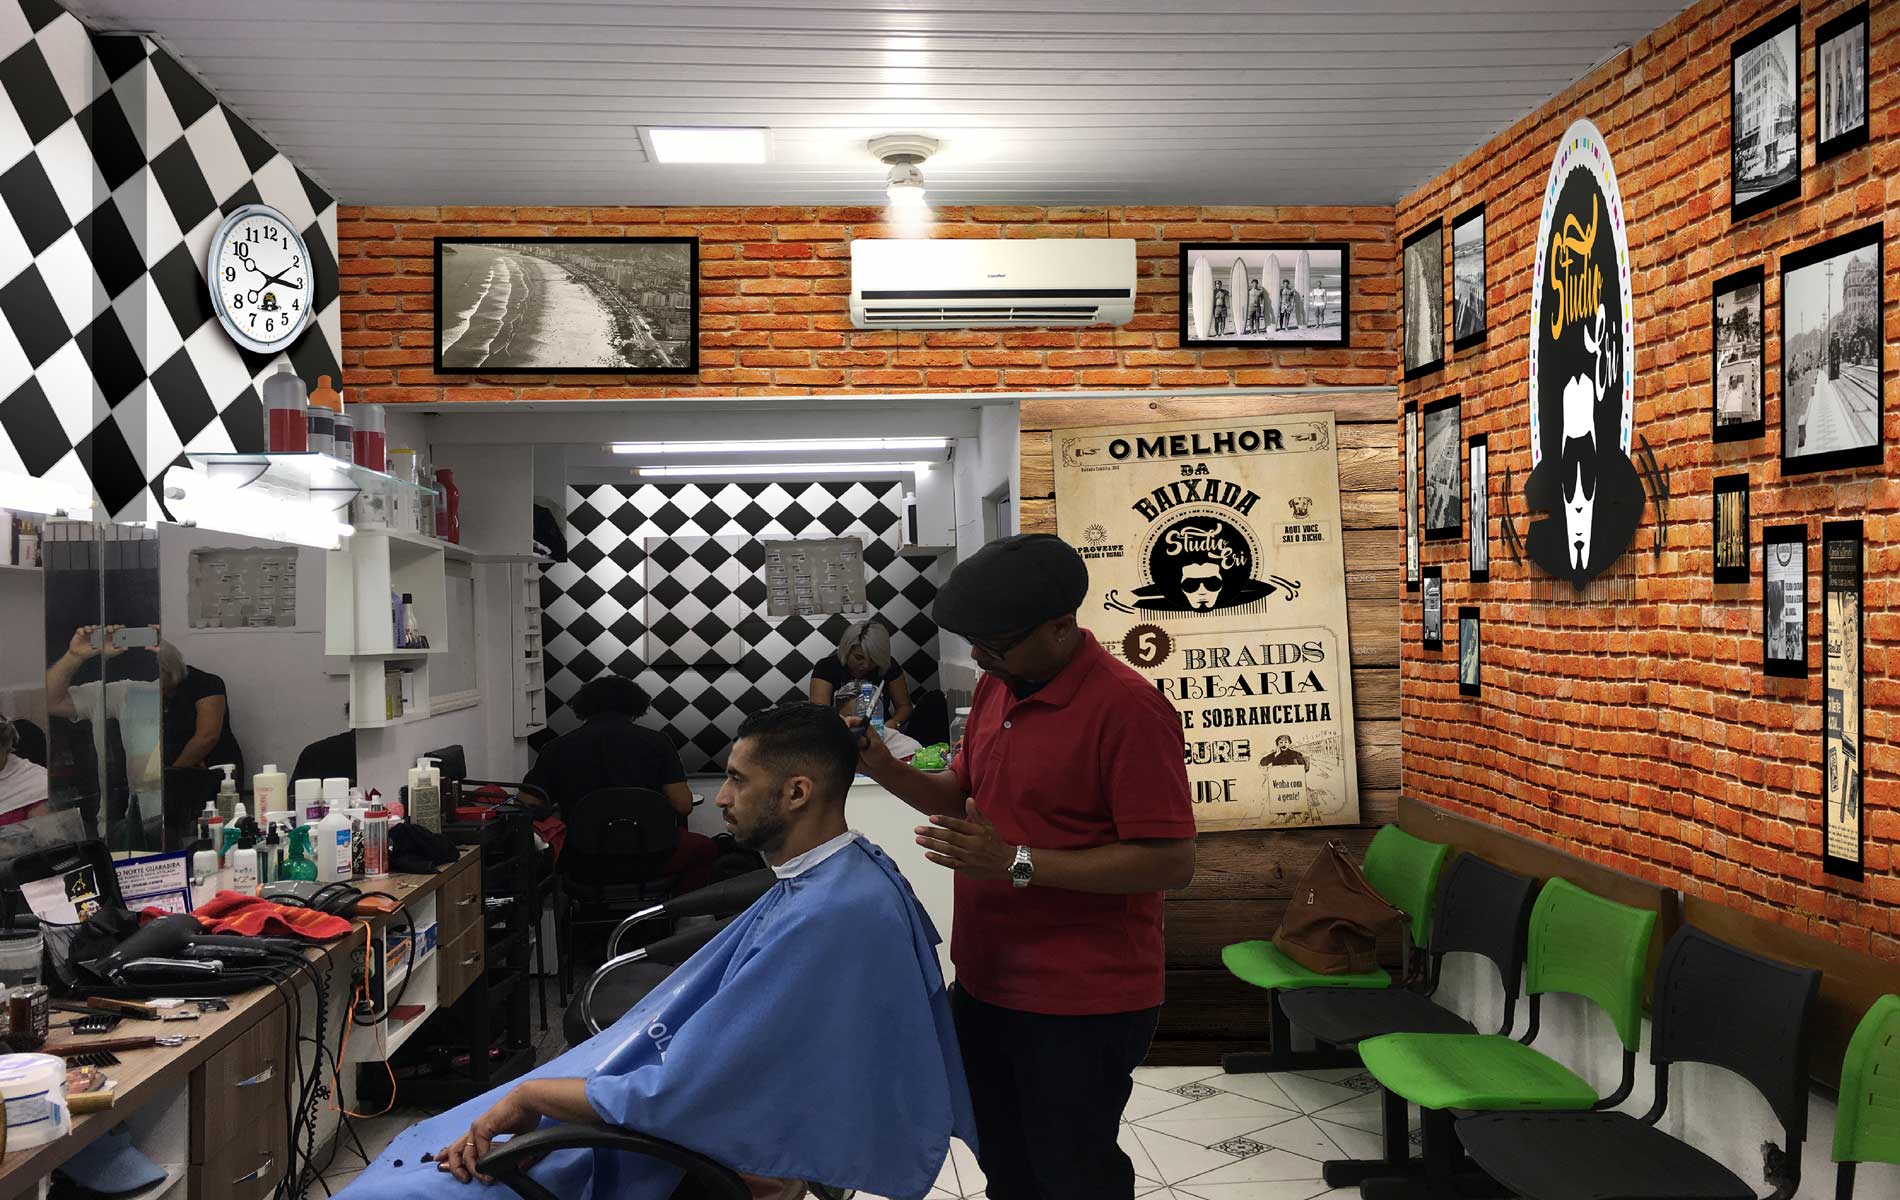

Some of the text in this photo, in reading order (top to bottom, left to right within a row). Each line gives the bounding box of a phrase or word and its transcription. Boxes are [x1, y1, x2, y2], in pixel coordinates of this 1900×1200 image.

[245, 227, 260, 243] 11
[263, 225, 278, 242] 12
[233, 241, 249, 257] 10
[282, 237, 288, 250] 1
[293, 255, 300, 268] 2
[1551, 192, 1604, 340] Studio
[225, 266, 236, 282] 9
[233, 293, 243, 309] 8
[292, 298, 299, 311] 4
[249, 313, 257, 327] 7
[265, 318, 274, 332] 6
[281, 312, 289, 326] 5
[1584, 303, 1620, 402] Eri
[1108, 428, 1285, 460] O MELHOR
[1180, 462, 1210, 477] DA
[1132, 478, 1261, 523] BAIXADA
[1284, 525, 1301, 534] AQUI
[1165, 523, 1229, 556] Studio
[1282, 534, 1294, 543] SAI
[1295, 534, 1300, 542] O
[1073, 544, 1124, 554] PROVEITE
[1207, 547, 1248, 570] Eri
[1138, 632, 1157, 662] 5
[1181, 641, 1325, 671] BRAIDS
[1202, 702, 1333, 729] SOBRANCELHA
[1272, 779, 1290, 789] Venha
[124, 866, 144, 876] NORTE
[145, 862, 181, 873] GUARABIRA
